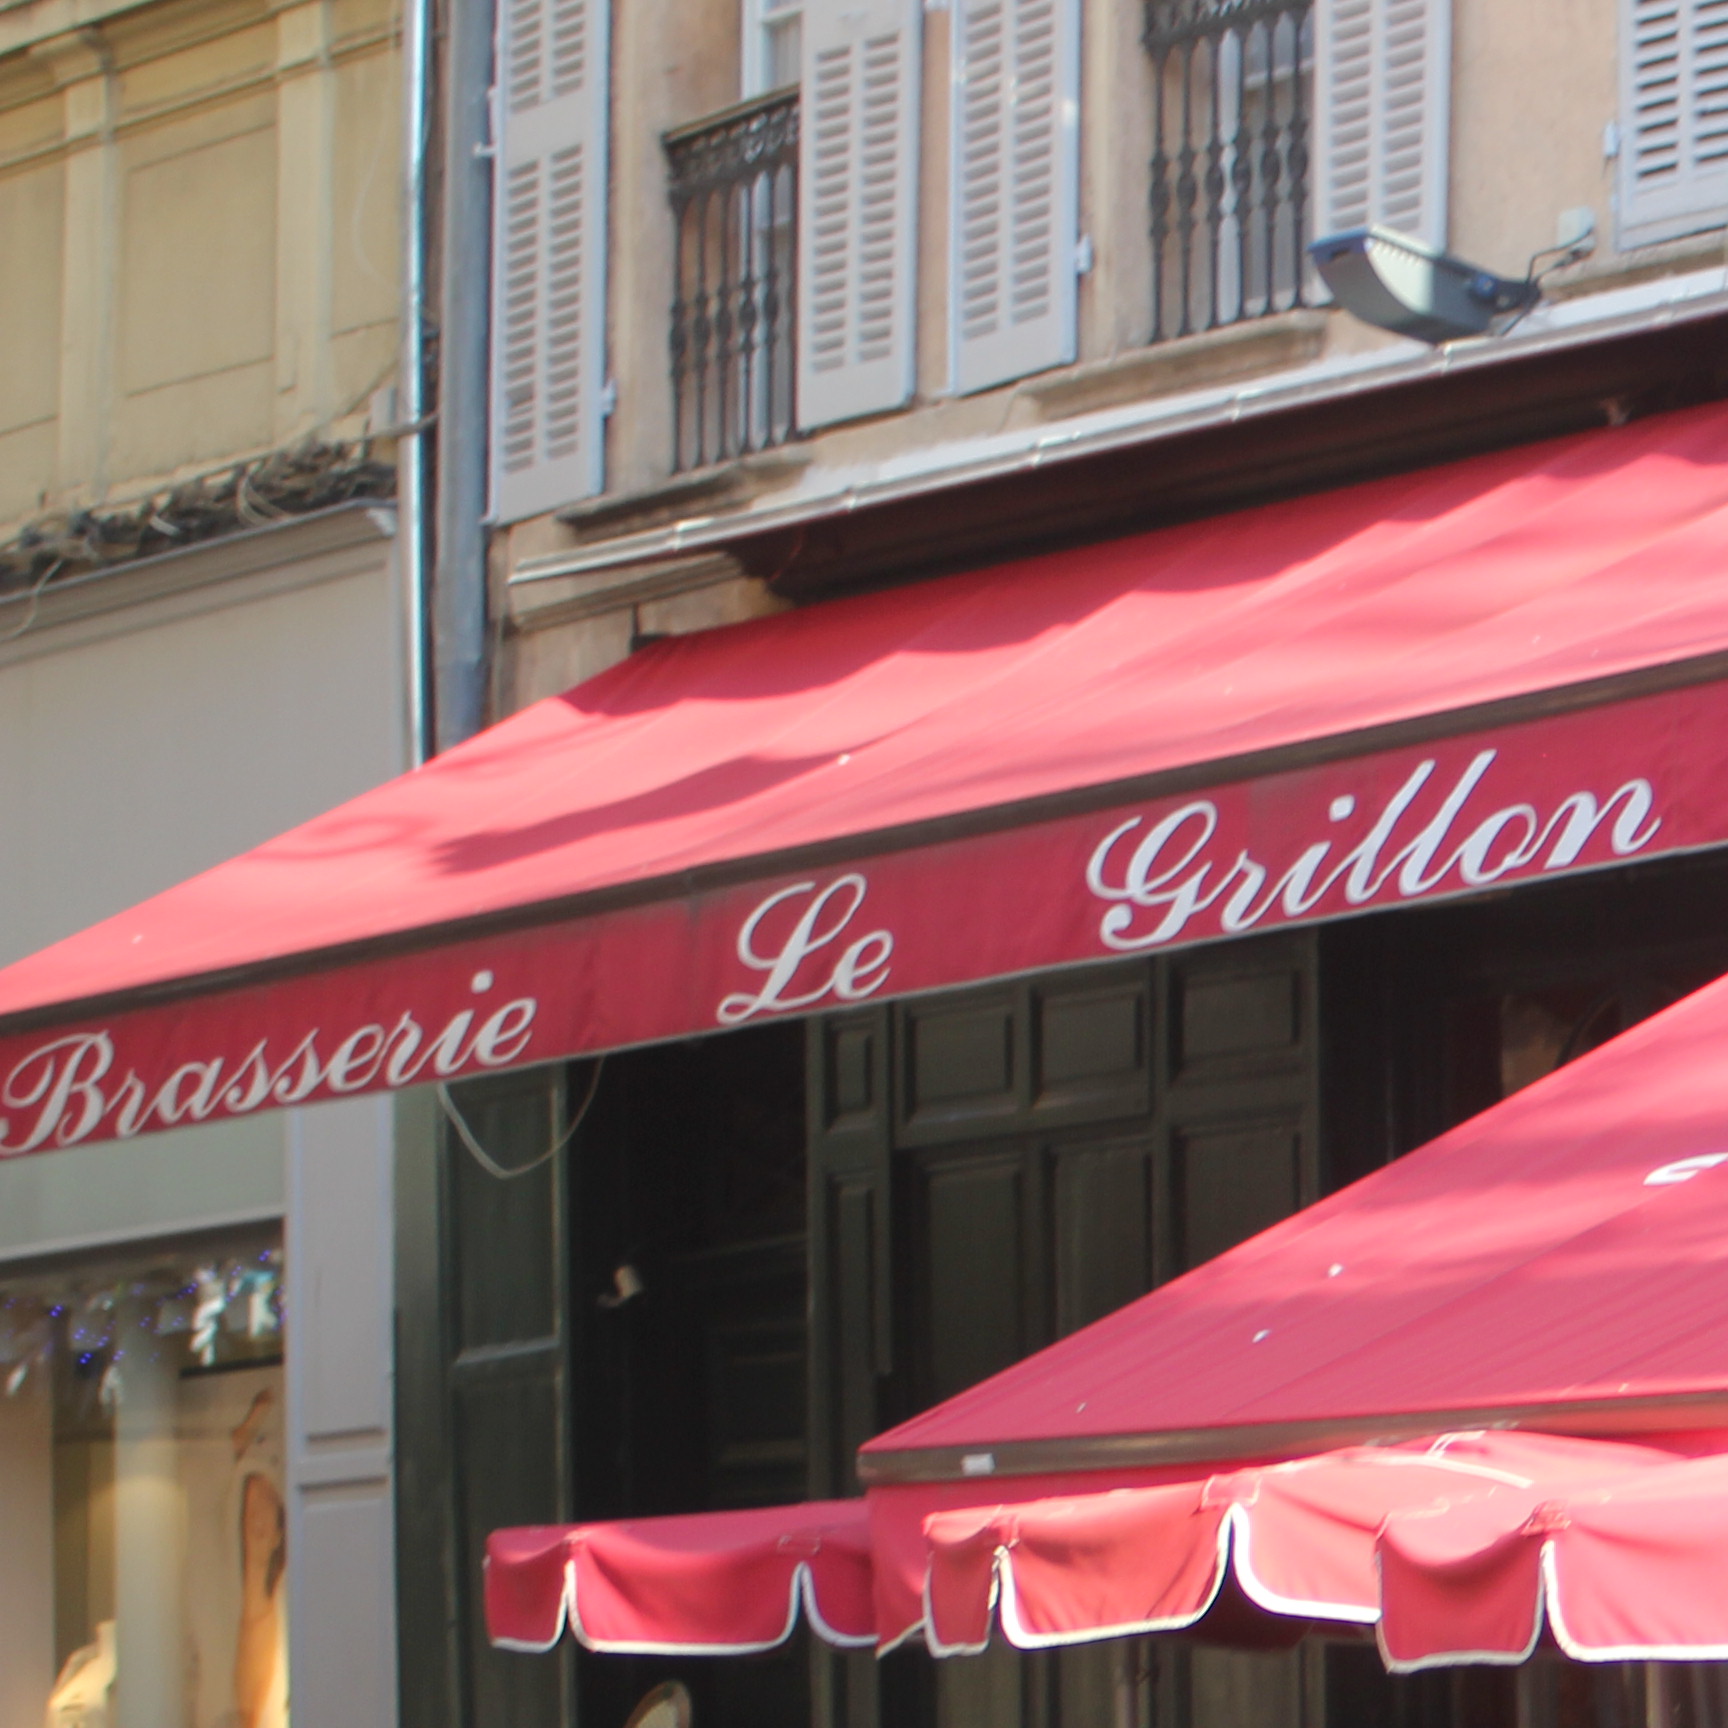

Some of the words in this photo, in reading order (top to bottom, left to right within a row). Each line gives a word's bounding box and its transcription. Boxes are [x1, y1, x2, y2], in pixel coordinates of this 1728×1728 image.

[0, 971, 537, 1155] Brasserie
[716, 872, 894, 1024] Le
[1086, 749, 1662, 950] Grillon
